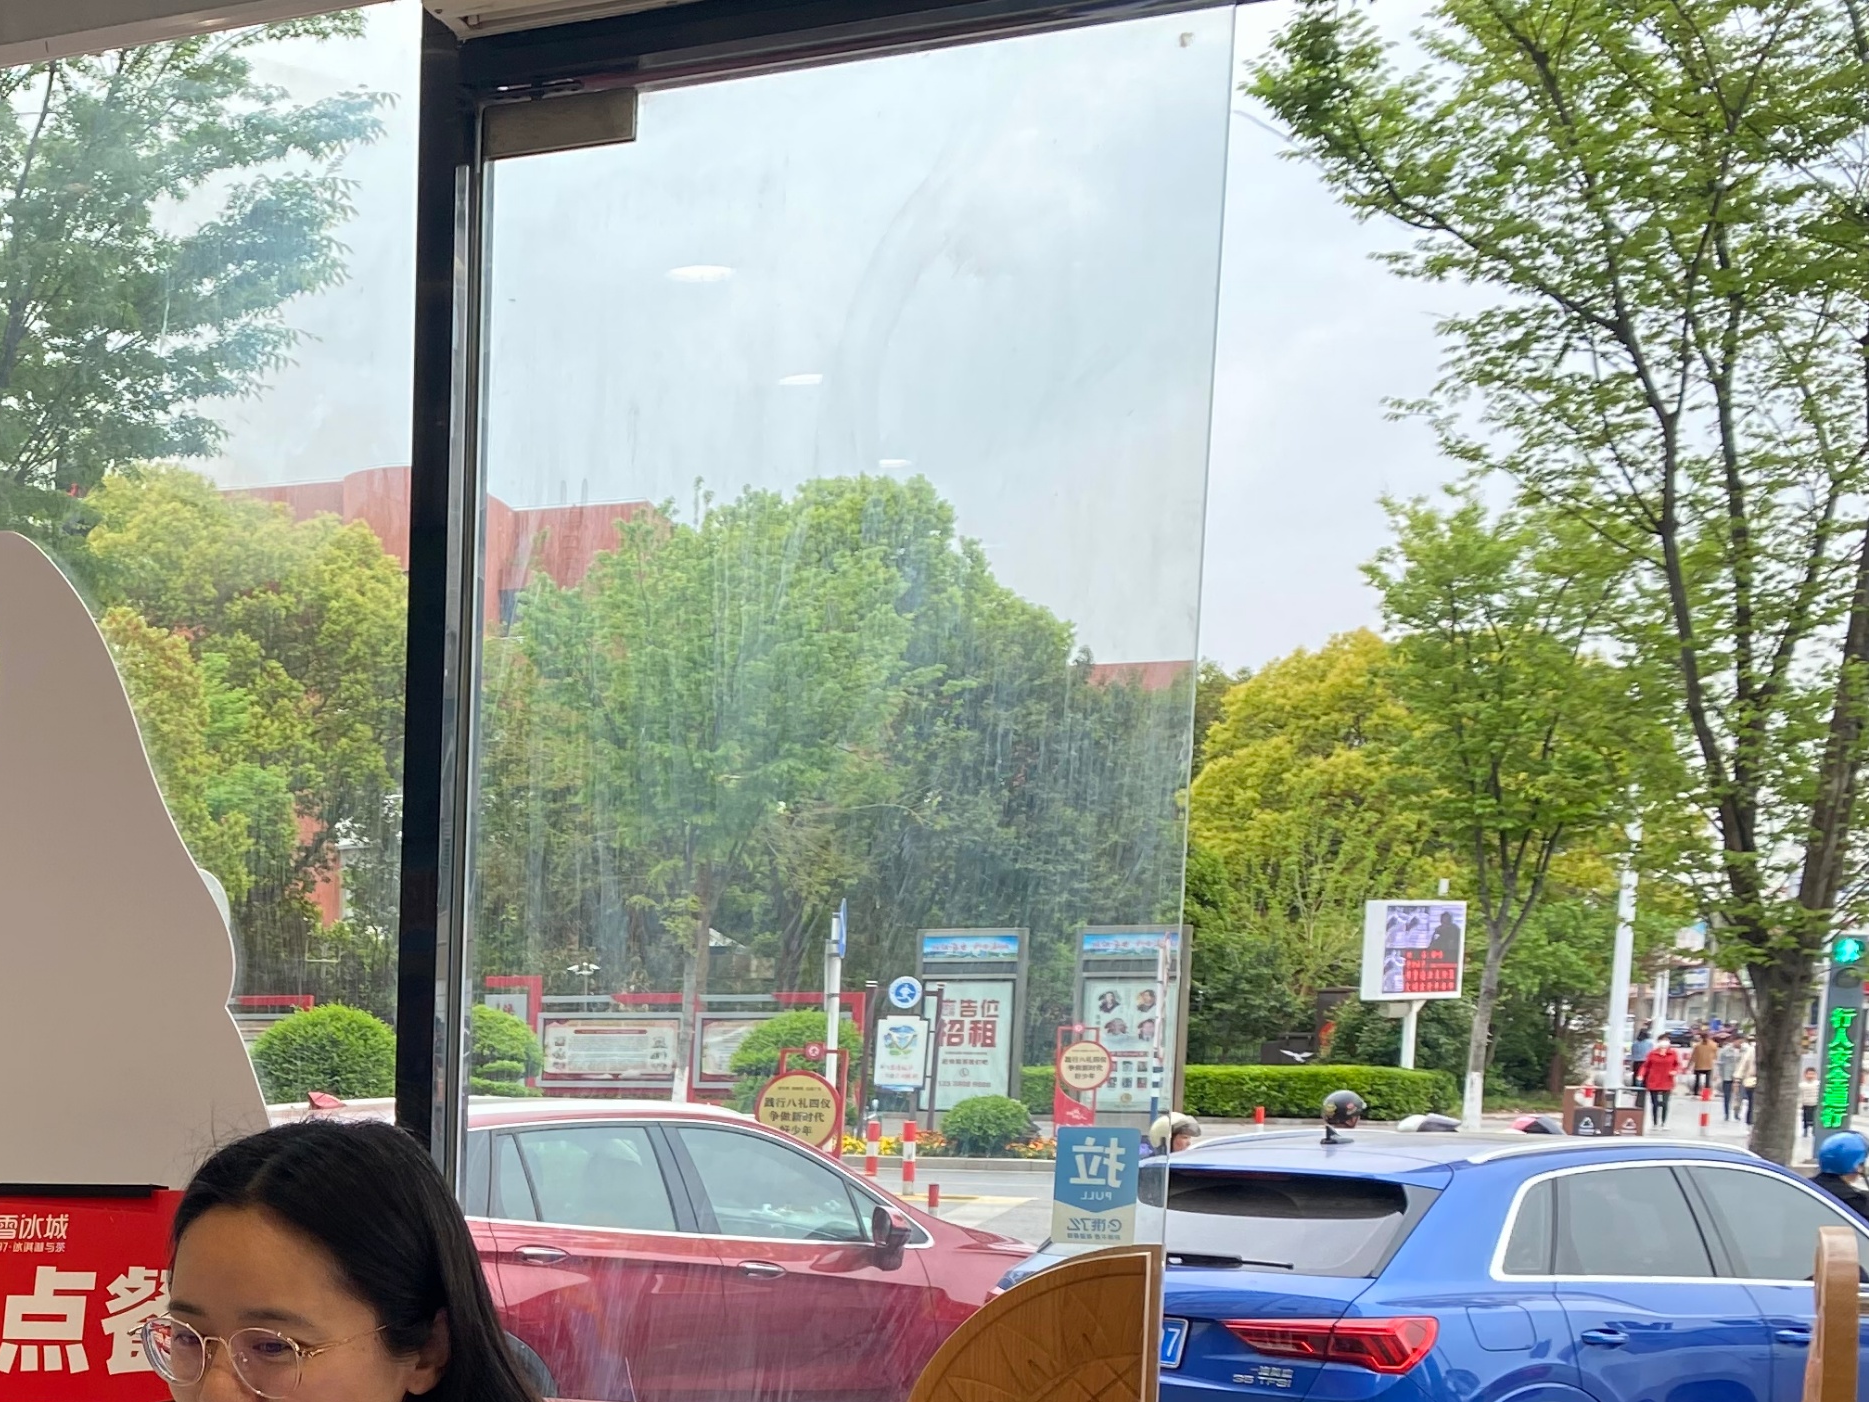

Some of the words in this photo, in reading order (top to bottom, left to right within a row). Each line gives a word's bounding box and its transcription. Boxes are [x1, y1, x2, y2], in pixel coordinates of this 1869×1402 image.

[764, 1097, 831, 1109] 践行八礼四仪
[769, 1111, 825, 1123] 争做新时代
